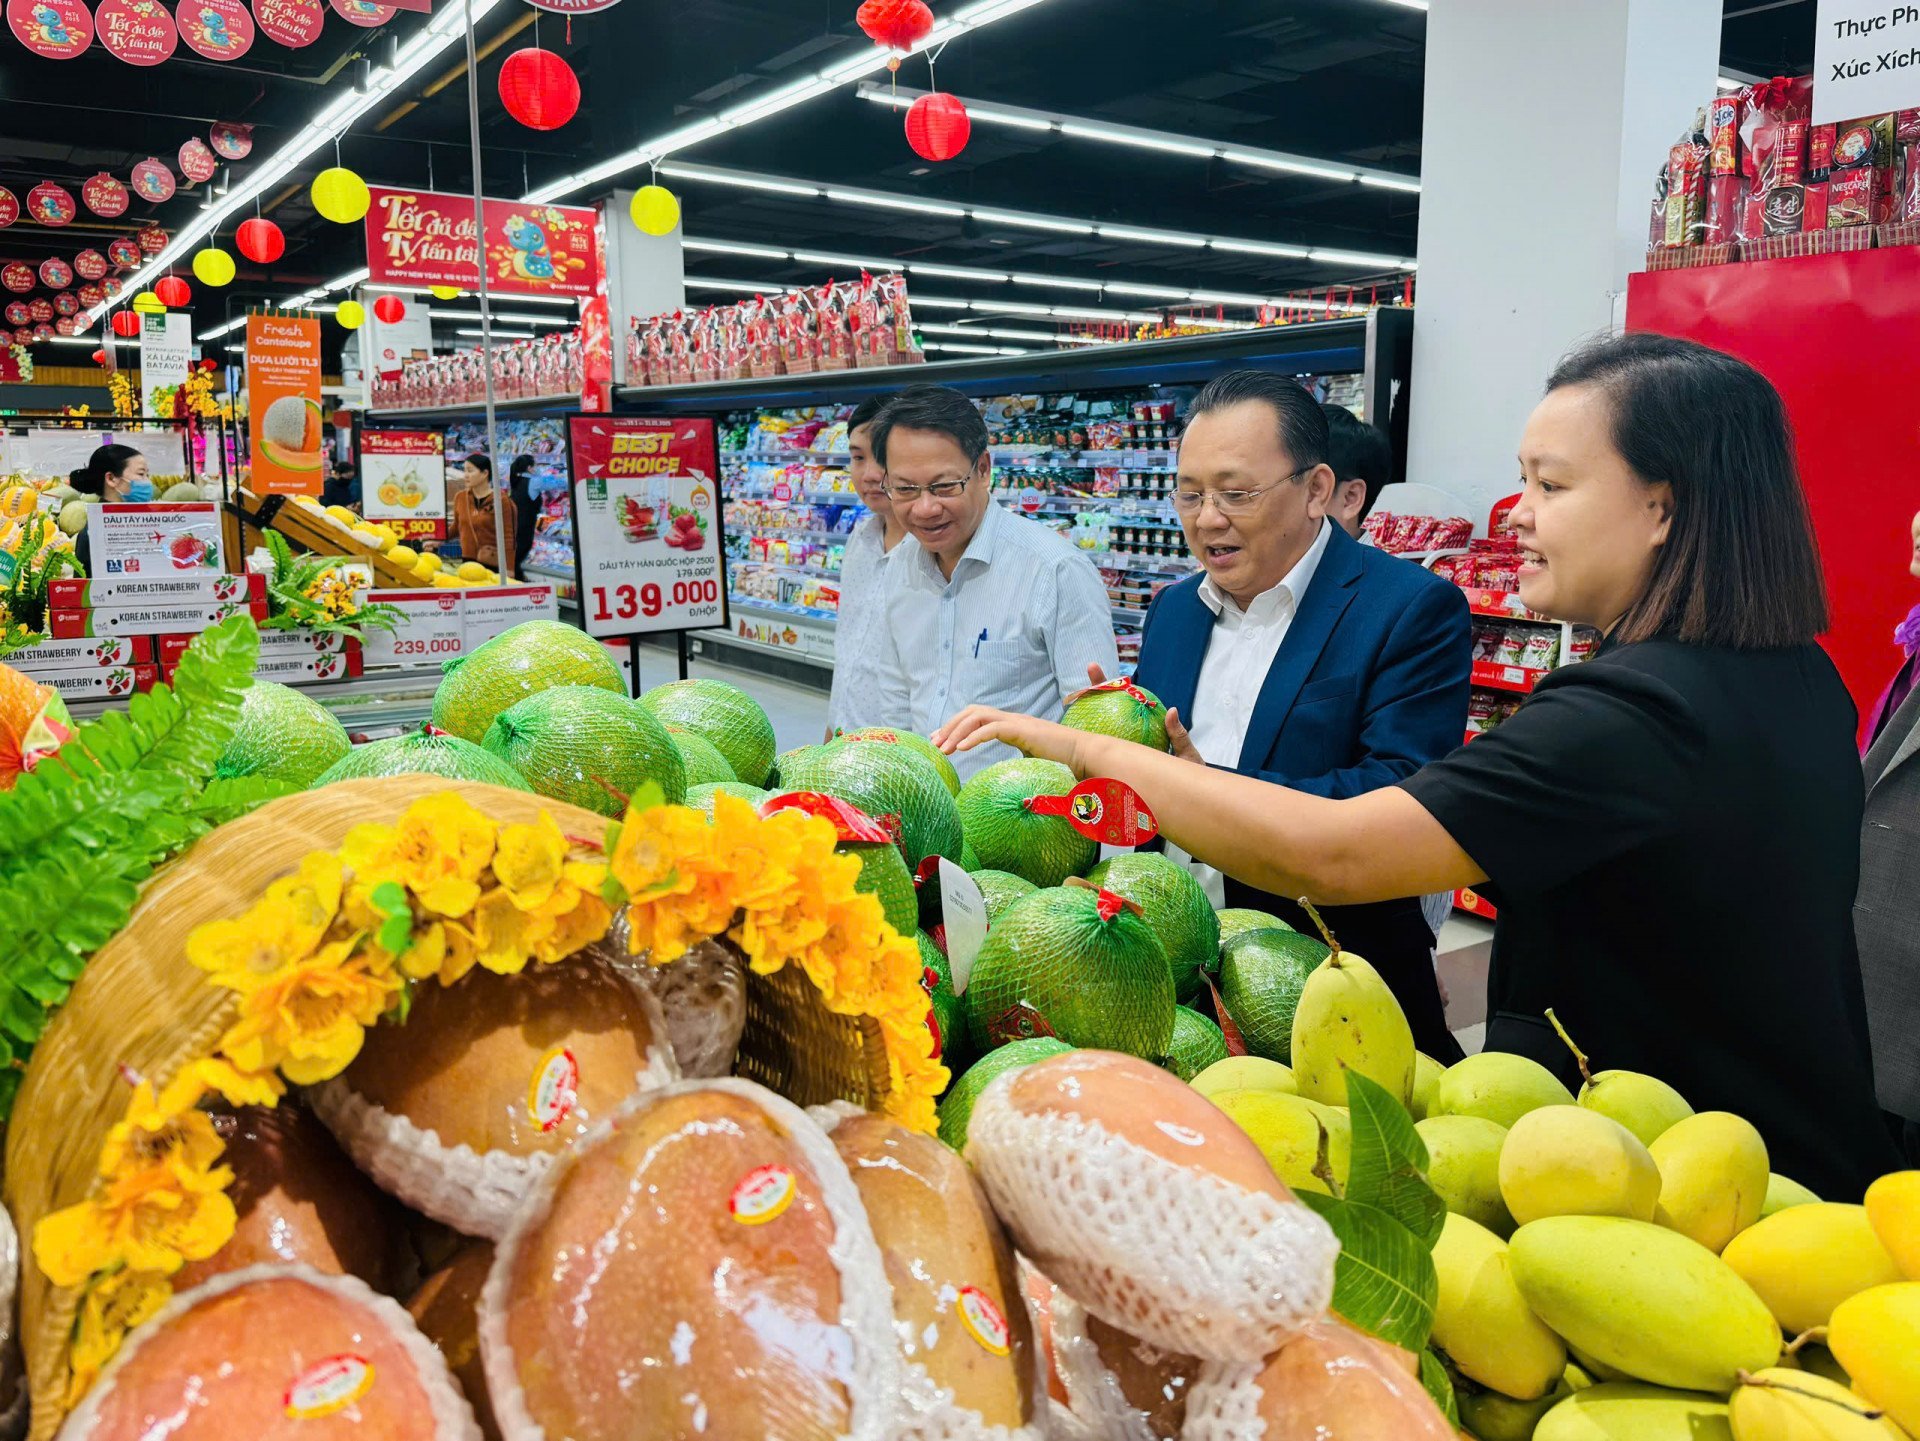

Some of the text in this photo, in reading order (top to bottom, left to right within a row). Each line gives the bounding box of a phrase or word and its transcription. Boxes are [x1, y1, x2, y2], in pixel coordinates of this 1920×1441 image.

[1834, 6, 1920, 39] Thực Ph
[1831, 48, 1920, 81] Xúc Xích
[379, 195, 439, 231] Tết
[426, 217, 460, 240] đủ
[382, 231, 433, 267] Tỵ
[421, 242, 453, 261] tấn
[385, 269, 408, 277] HAPPY
[263, 323, 303, 337] Fresh
[255, 337, 312, 348] Cantaloupe
[611, 432, 676, 454] BEST
[609, 457, 680, 474] CHOICE
[1022, 495, 1039, 503] NEW
[103, 514, 186, 524] DÂU TÂY HÀN QUỐC
[599, 556, 715, 570] DÂU TÂY HÀN QUỐC HỘP 250G
[117, 582, 200, 594] KOREAN STRAWBERRY
[592, 579, 718, 621] 139.000
[119, 610, 203, 621] KOREAN STRAWBERRY
[689, 605, 718, 617] Đ/HỘP
[27, 648, 82, 659] STRAWBERRY
[394, 639, 461, 655] 239,000
[256, 661, 303, 672] STRAWBERRY
